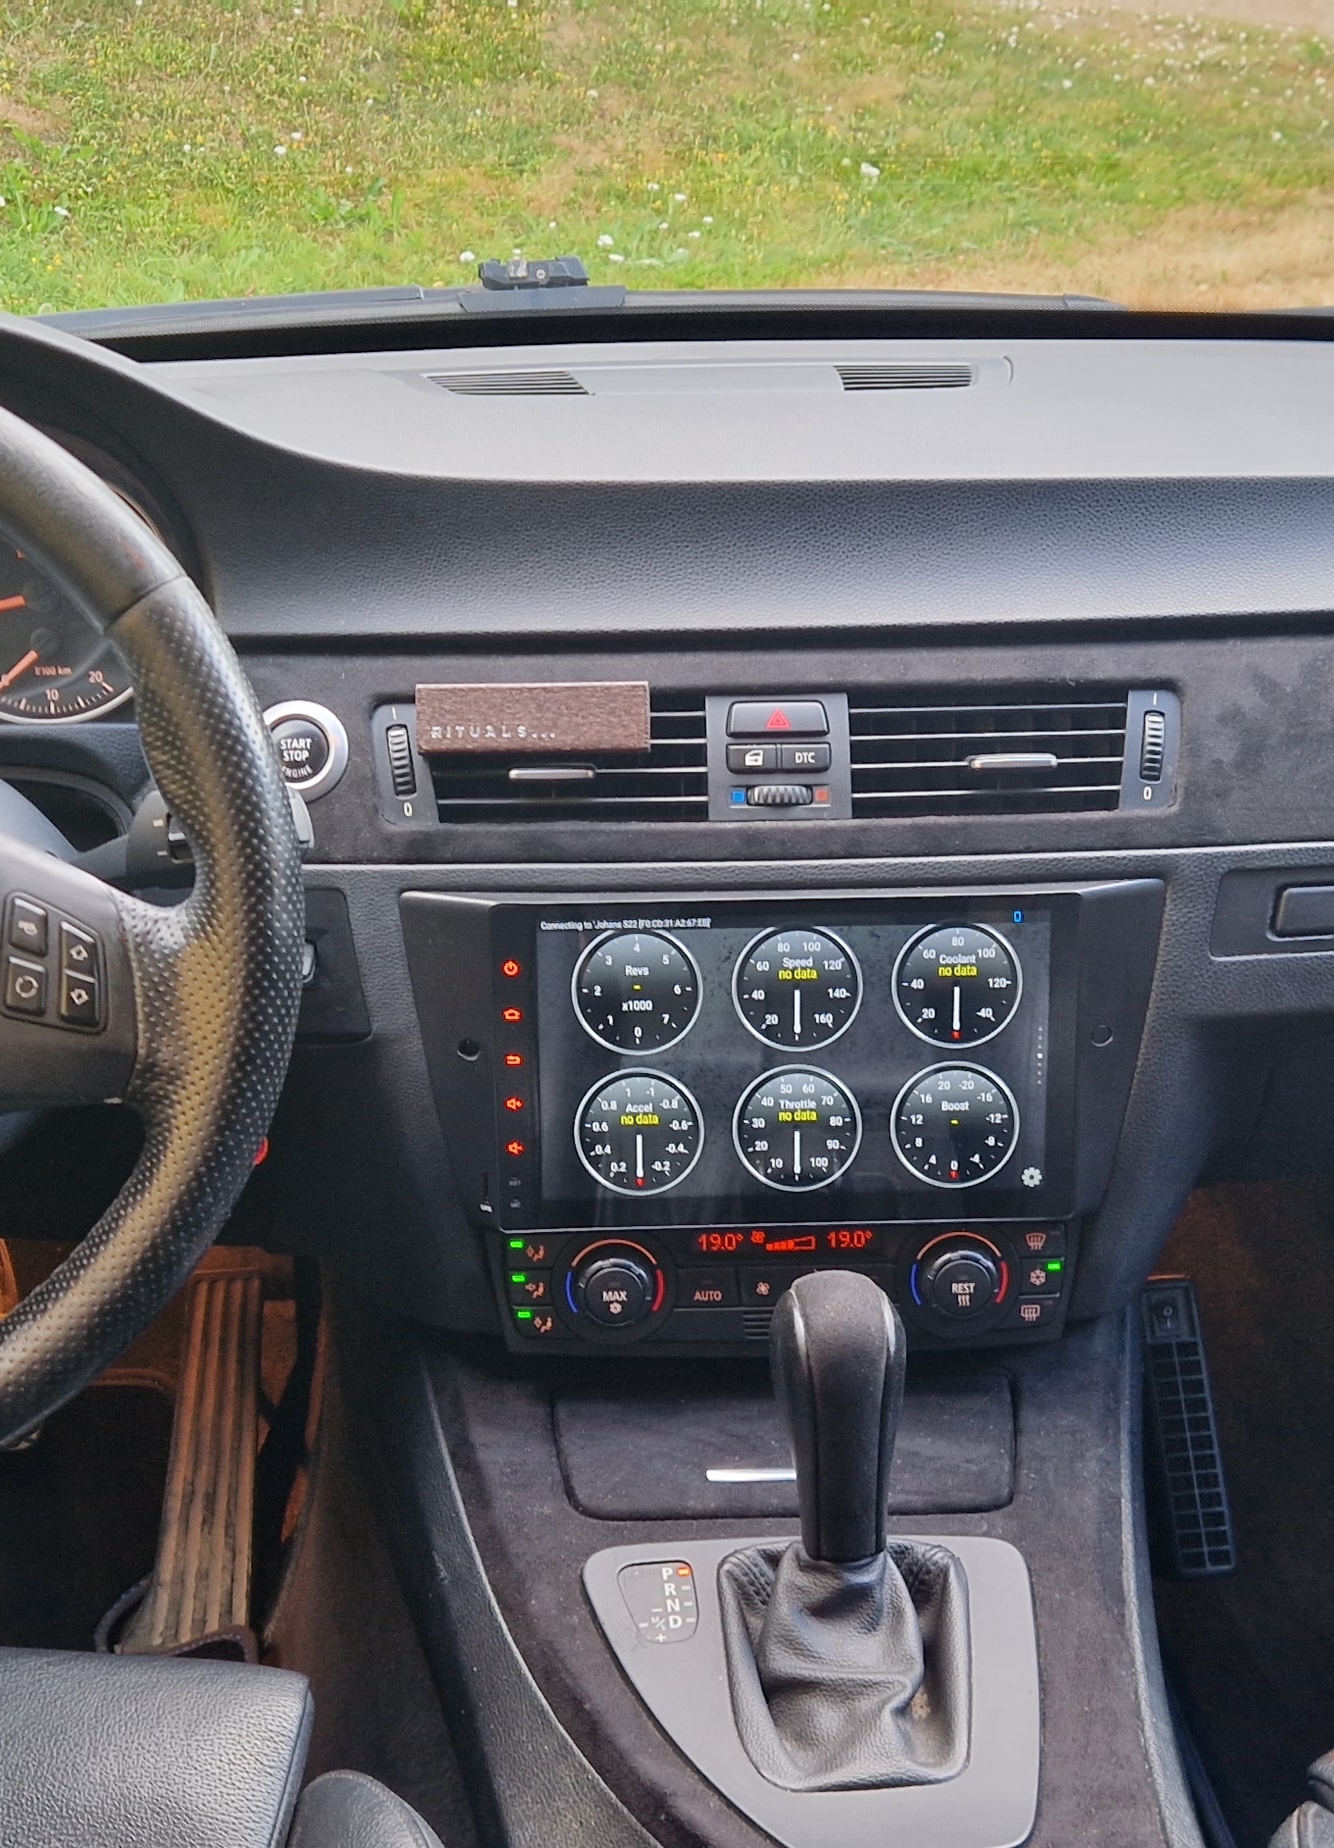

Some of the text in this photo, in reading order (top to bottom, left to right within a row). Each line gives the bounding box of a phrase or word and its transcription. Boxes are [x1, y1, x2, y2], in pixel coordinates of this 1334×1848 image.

[88, 671, 103, 683] 20
[46, 689, 59, 700] 10
[280, 738, 312, 750] START
[283, 750, 310, 762] STOP
[794, 752, 816, 764] DTC
[952, 936, 964, 947] 80
[633, 942, 640, 953] 4
[777, 942, 820, 953] 80 100
[977, 947, 995, 959] 100
[662, 954, 669, 965] 5
[923, 949, 936, 960] 60
[939, 954, 976, 965] Coolant
[605, 955, 612, 966] 3
[782, 957, 813, 970] Speed
[823, 960, 842, 971] 120
[625, 965, 649, 976] Revs
[756, 961, 769, 972] 60
[938, 965, 977, 977] no data
[778, 968, 817, 980] no data
[910, 978, 924, 990] 40
[988, 978, 1006, 989] 120
[594, 985, 601, 996] 2
[674, 985, 681, 995] 6
[751, 989, 765, 1000] 40
[827, 988, 846, 999] 140
[622, 1000, 653, 1012] x1000
[814, 1013, 833, 1025] 160
[922, 1008, 935, 1019] 20
[607, 1015, 613, 1026] 1
[662, 1014, 669, 1025] 7
[765, 1014, 778, 1025] 20
[634, 1027, 642, 1038] 0
[779, 1083, 814, 1094] 50 60
[938, 1080, 974, 1090] 20 -20
[659, 1099, 678, 1109] -0.8
[761, 1097, 774, 1107] 40
[821, 1095, 834, 1106] 70
[920, 1093, 932, 1104] 16
[601, 1101, 617, 1111] 0.8
[626, 1102, 653, 1113] Accel
[779, 1099, 816, 1110] Throttle
[941, 1100, 969, 1111] Boost
[621, 1114, 659, 1125] no data
[778, 1110, 817, 1122] no data
[830, 1116, 843, 1126] 80
[910, 1114, 923, 1125] 12
[593, 1122, 609, 1132] 0.6
[752, 1118, 765, 1128] 30
[755, 1140, 768, 1151] 20
[827, 1139, 839, 1150] 90
[915, 1137, 922, 1148] 8
[595, 1145, 611, 1155] 0.4
[611, 1162, 627, 1172] 0.2
[770, 1158, 783, 1169] 10
[810, 1157, 828, 1168] 100
[951, 1160, 958, 1171] 0
[951, 1282, 975, 1295] REST
[602, 1290, 628, 1302] MAX
[693, 1290, 723, 1302] AUTO
[661, 1567, 674, 1580] P
[664, 1583, 677, 1596] R
[667, 1599, 680, 1612] N
[669, 1615, 682, 1629] D
